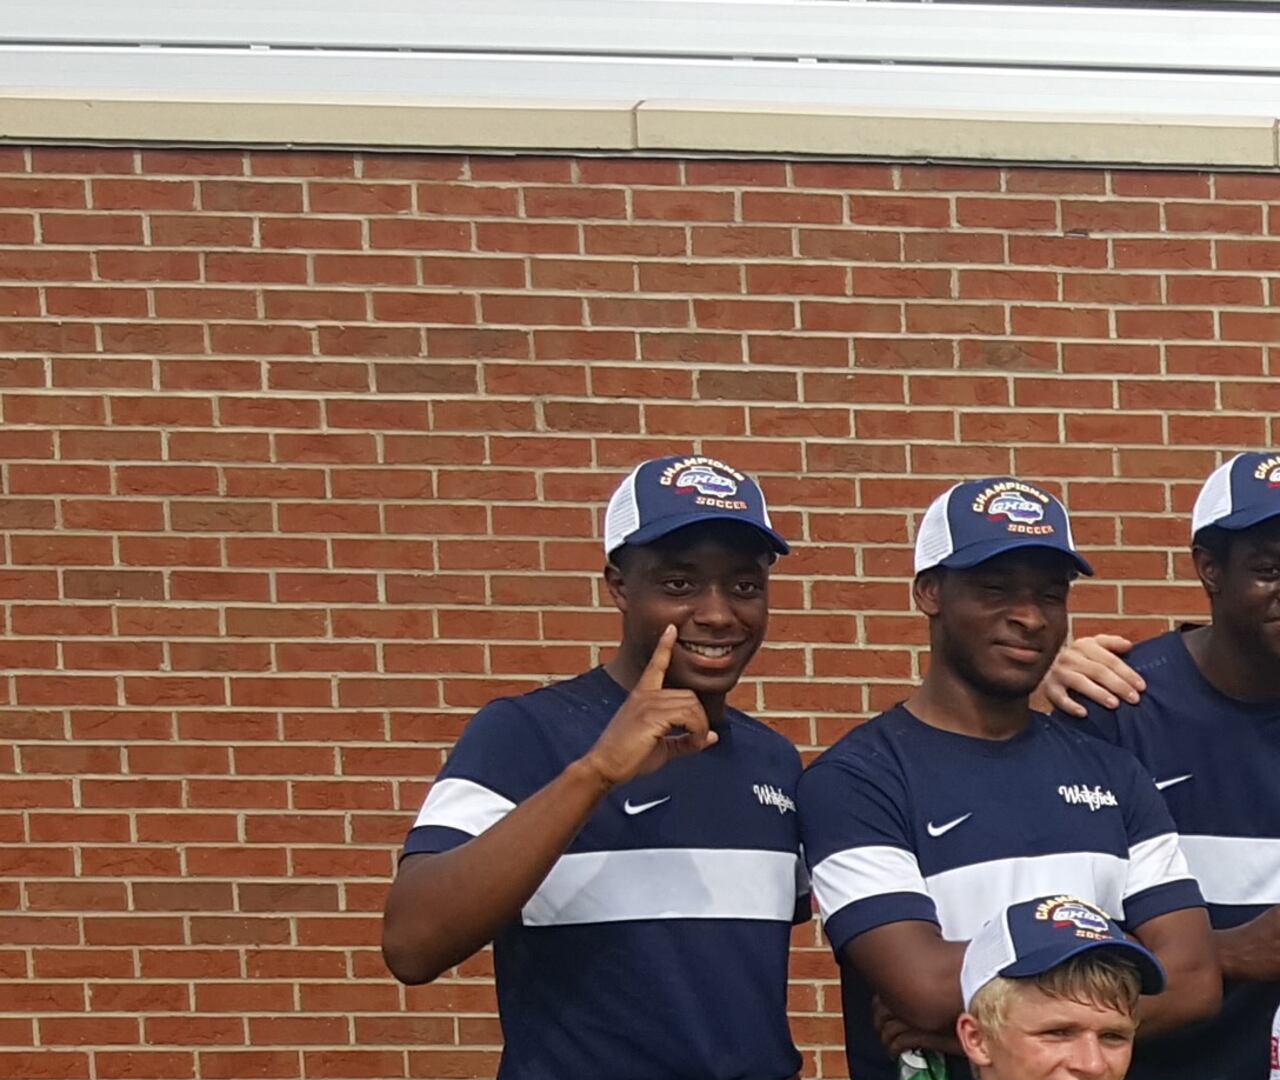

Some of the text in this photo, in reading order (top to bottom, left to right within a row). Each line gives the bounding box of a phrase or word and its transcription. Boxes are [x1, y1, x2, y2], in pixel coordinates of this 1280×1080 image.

[660, 457, 745, 486] CHAMPIONS
[680, 475, 736, 489] GHSA
[696, 497, 748, 509] SOCCER
[973, 482, 1048, 512] CHAMPIONS
[991, 501, 1043, 512] GHSA
[1007, 524, 1054, 533] SOCCER
